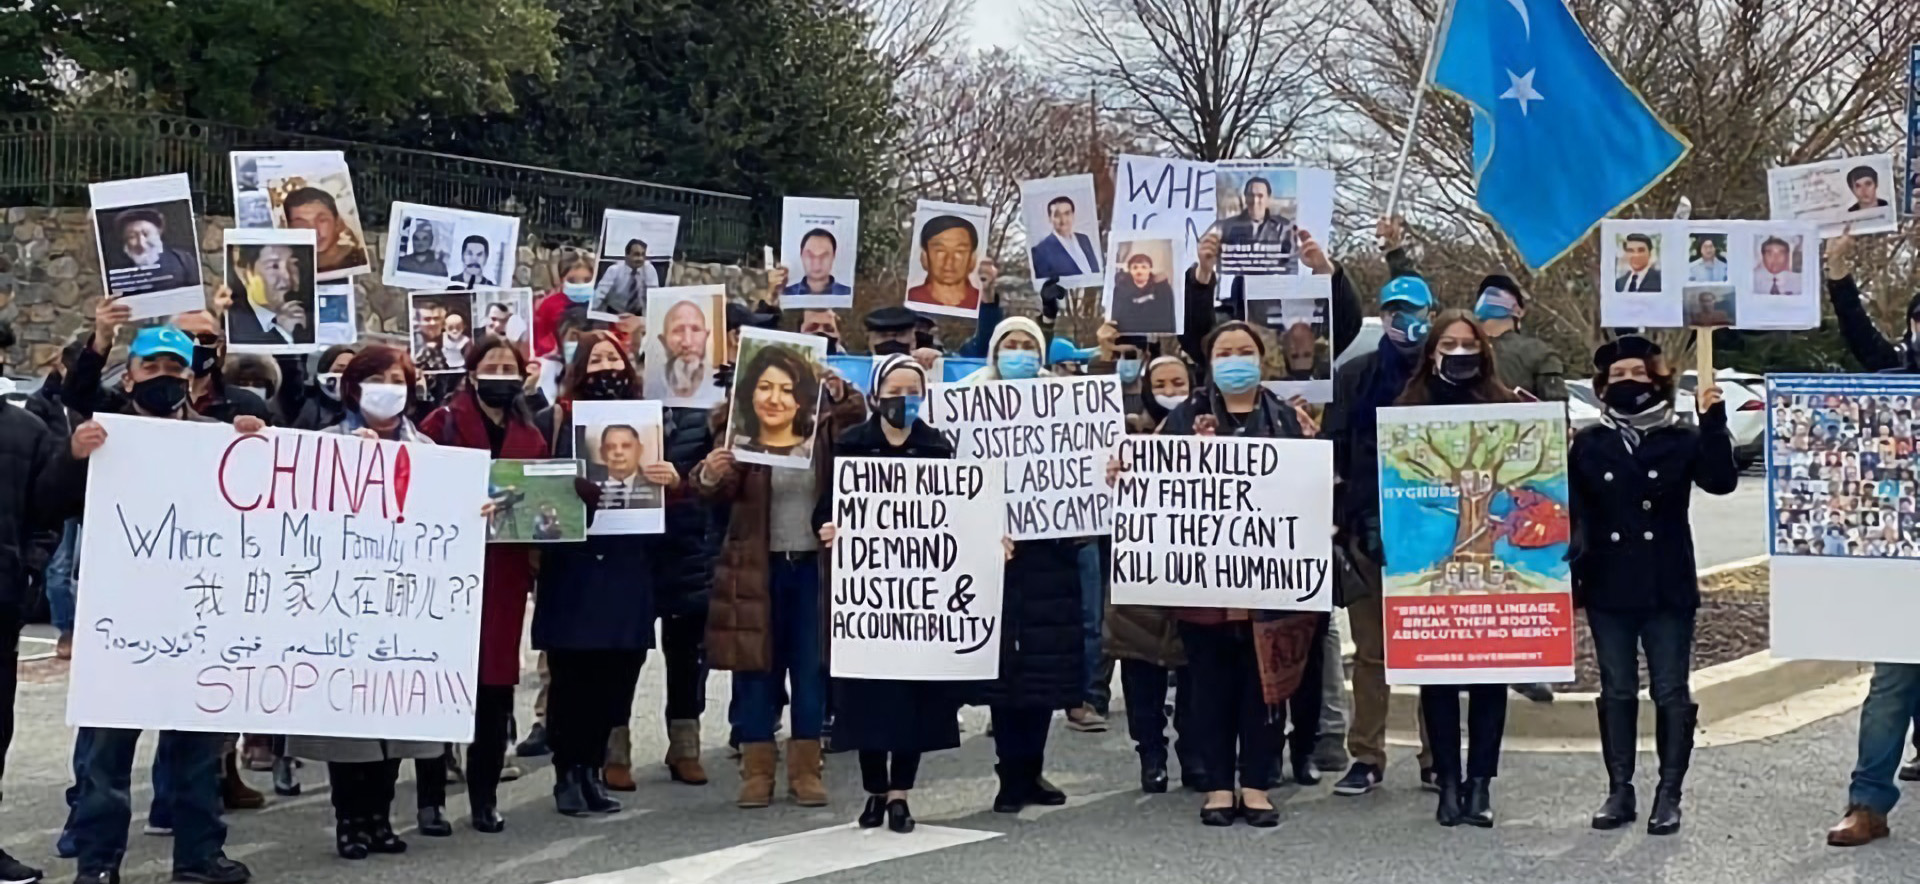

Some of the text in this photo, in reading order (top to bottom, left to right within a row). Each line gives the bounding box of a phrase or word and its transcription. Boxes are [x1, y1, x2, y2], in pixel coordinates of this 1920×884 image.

[928, 380, 1121, 423] I STAND UP FOR
[972, 424, 1044, 459] SISTERS
[1051, 420, 1119, 453] FACING
[1119, 438, 1278, 476] CHINA KILLED
[218, 434, 411, 523] CHINA!
[838, 460, 906, 494] CHINA
[916, 463, 983, 500] KILLED
[1020, 455, 1092, 493] ABUSE
[837, 497, 949, 530] MY CHILD.
[1117, 476, 1261, 512] MY FATHER.
[116, 503, 223, 560] Where
[241, 512, 261, 559] Is
[281, 512, 322, 575] My
[1115, 512, 1299, 550] BUT THEY CAN'T
[838, 532, 958, 572] I DEMAND
[1113, 547, 1328, 602] KILL OUR HUMANITY
[834, 574, 976, 615] JUSTICE &
[1451, 604, 1491, 614] THEIR
[833, 611, 995, 654] ACCOUNTABILITY
[1392, 628, 1483, 639] ABSOLUTELY
[1488, 627, 1509, 638] NO
[1403, 617, 1449, 628] BREAK
[1455, 615, 1496, 626] THEIR
[196, 662, 319, 714] STOP
